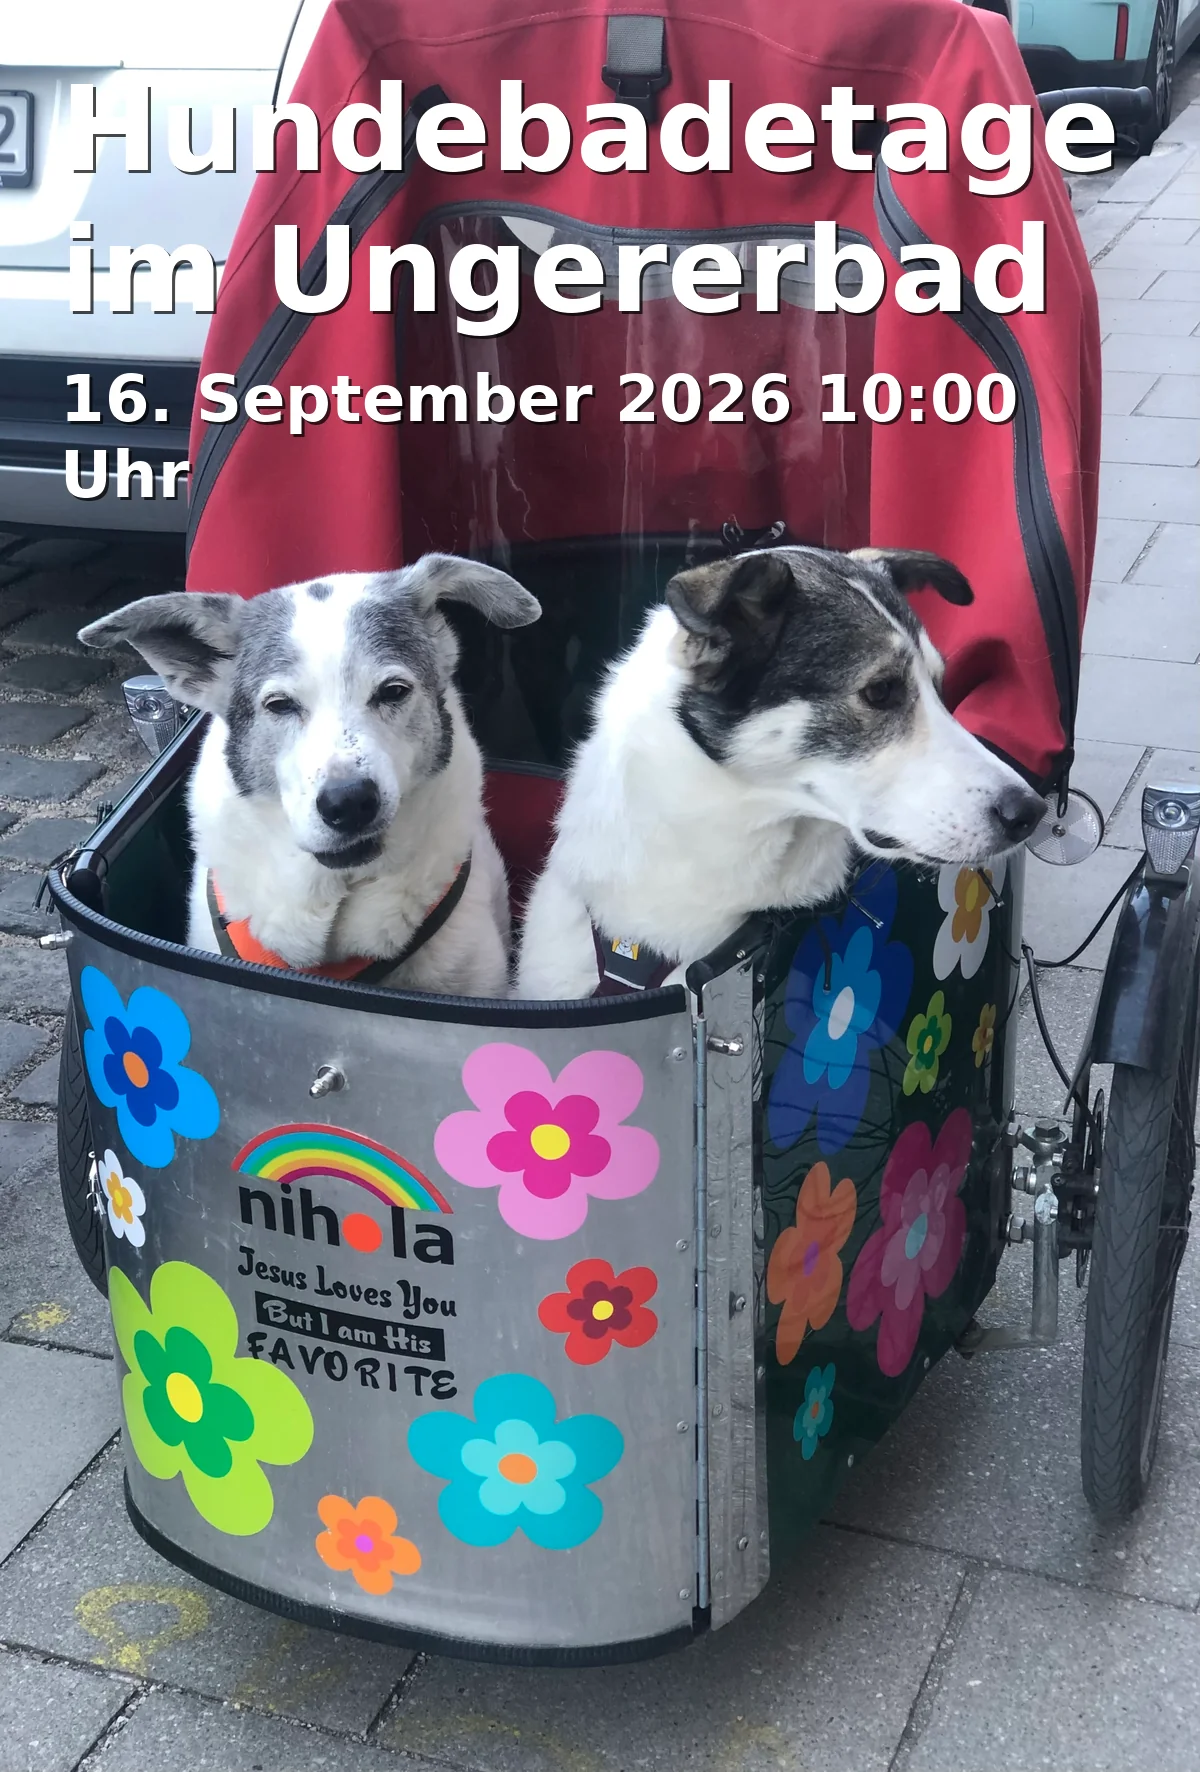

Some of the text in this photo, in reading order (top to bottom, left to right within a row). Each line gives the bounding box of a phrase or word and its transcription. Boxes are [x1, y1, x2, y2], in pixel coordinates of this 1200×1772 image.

[238, 1245, 458, 1320] Jesus Loves You
[262, 1300, 432, 1354] But I am His
[246, 1331, 458, 1400] FAVORITE
